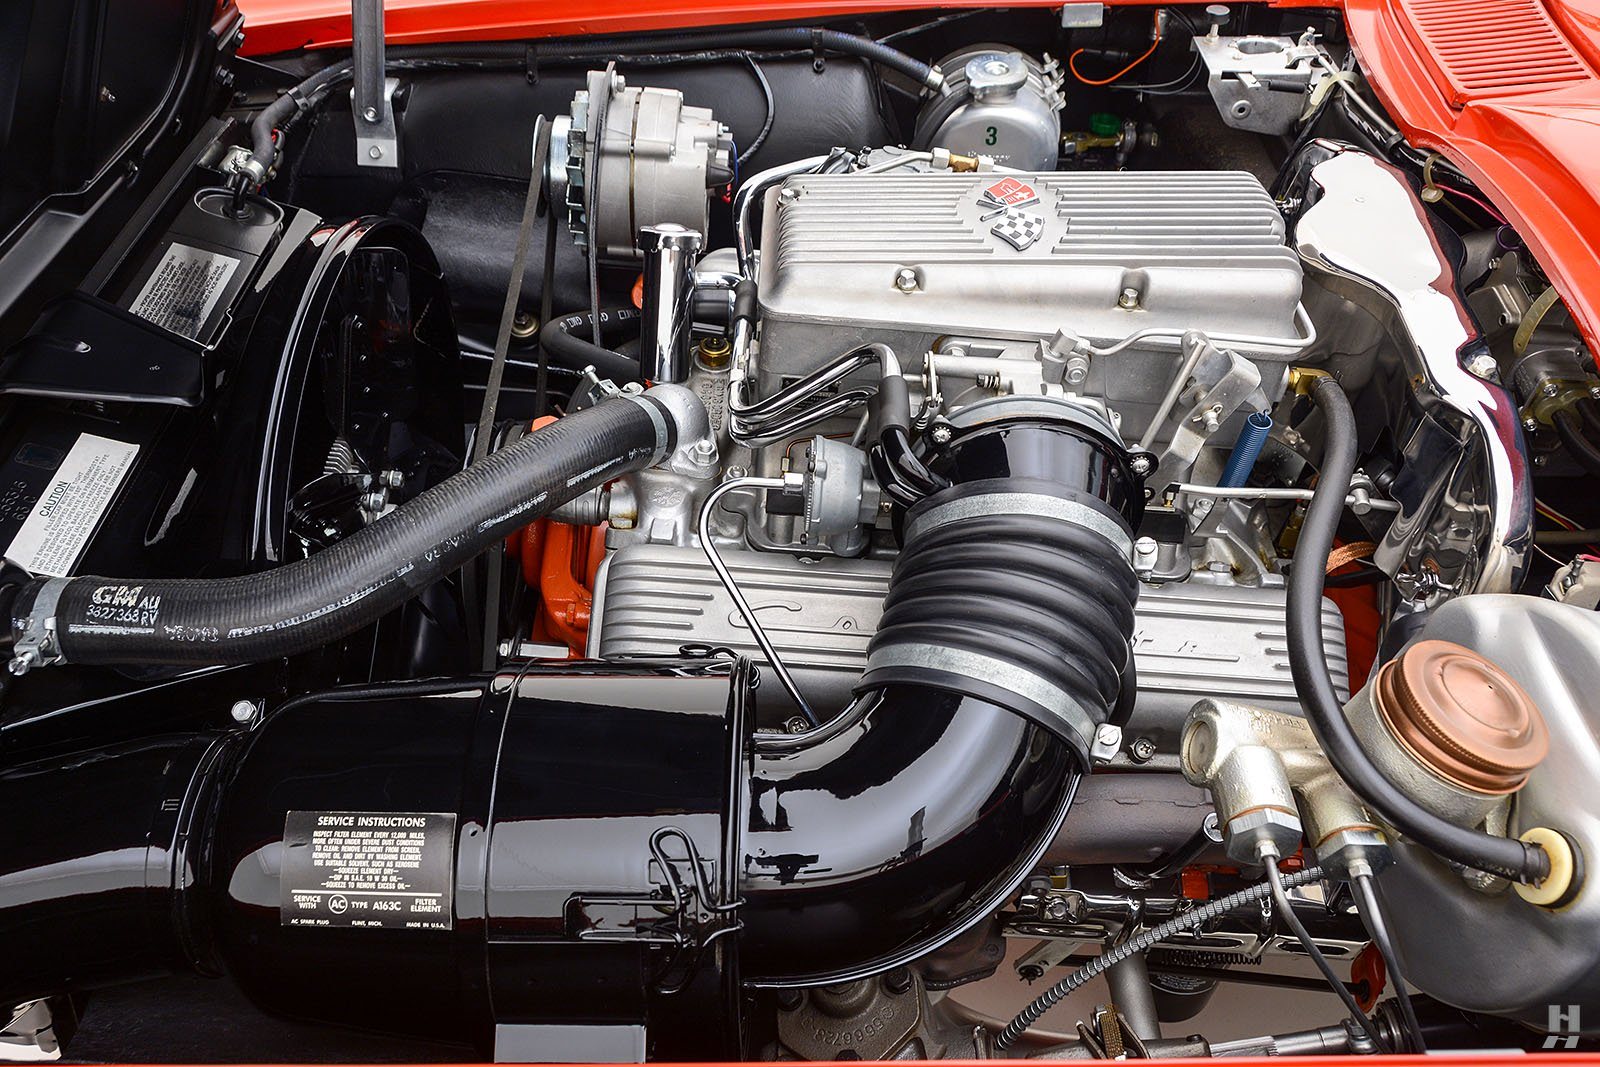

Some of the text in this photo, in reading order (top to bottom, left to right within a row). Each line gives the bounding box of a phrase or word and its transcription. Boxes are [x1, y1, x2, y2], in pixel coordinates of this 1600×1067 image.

[986, 126, 998, 146] 3
[40, 481, 68, 517] CAUTION
[37, 538, 50, 556] ENGINE
[52, 508, 69, 531] EQUIPPED
[46, 528, 64, 552] DESIGNED
[66, 500, 81, 520] OPERATE
[60, 525, 73, 543] GLYCOL
[50, 546, 68, 572] METHANOL
[57, 537, 82, 574] RECOMMENDED
[92, 586, 143, 607] GM
[318, 816, 426, 827] SERVICE INSTRUCTIONS
[373, 899, 402, 911] A163C
